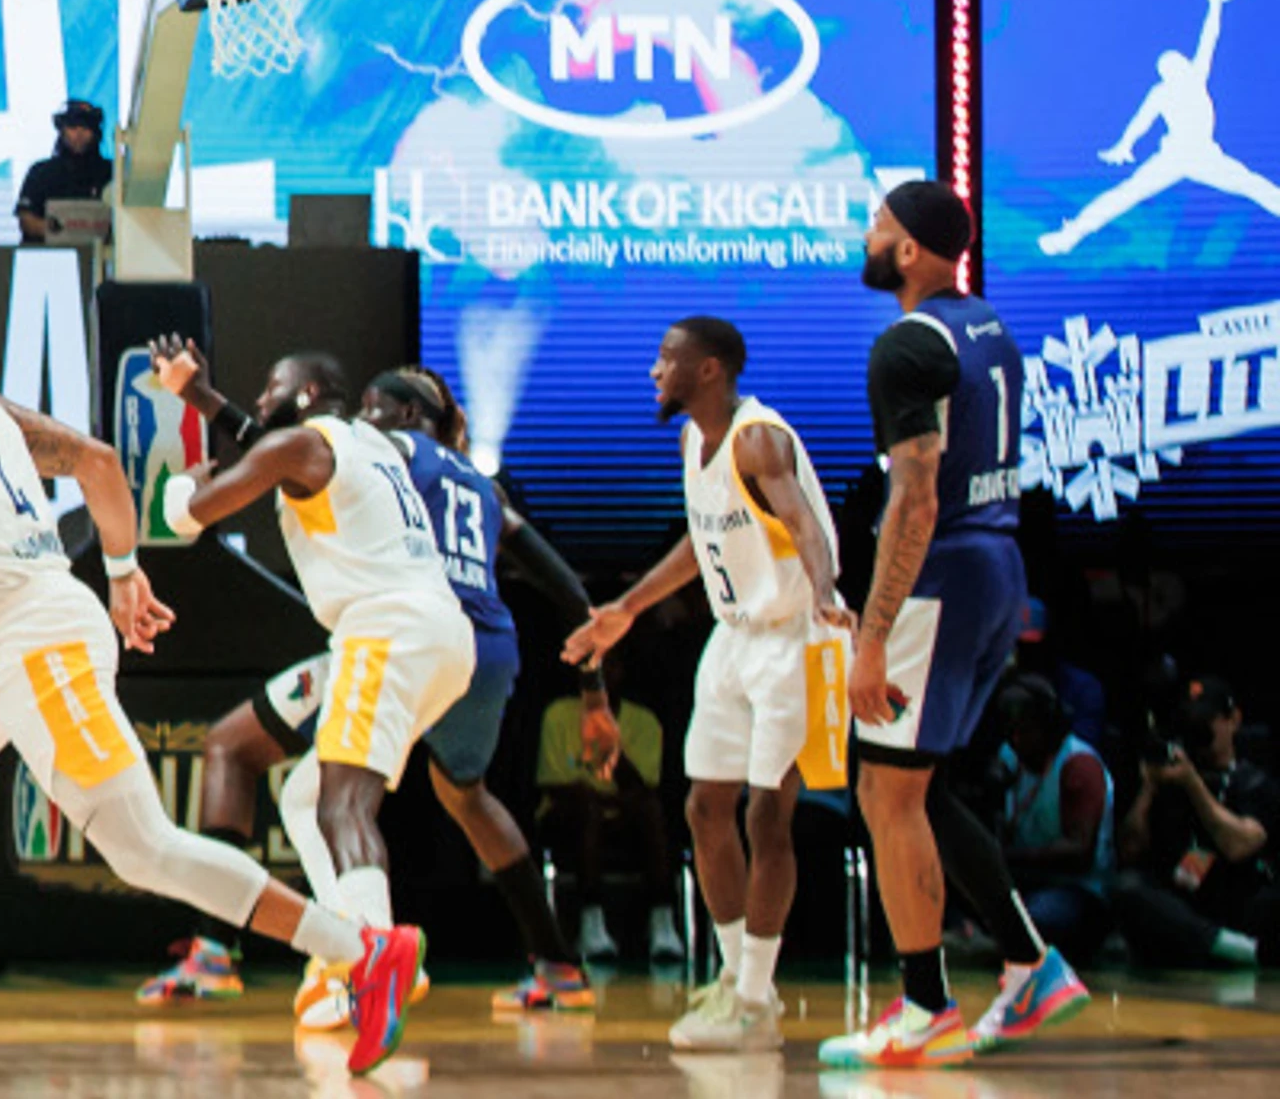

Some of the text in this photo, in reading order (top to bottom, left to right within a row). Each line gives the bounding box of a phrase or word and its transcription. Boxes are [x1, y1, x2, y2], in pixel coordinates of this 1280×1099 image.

[550, 14, 732, 81] MTN
[488, 179, 849, 230] BANK OF KIGALI
[488, 232, 847, 269] Financially transforming lives
[1162, 345, 1278, 426] LIT
[124, 395, 142, 489] BAL
[441, 477, 487, 562] 13
